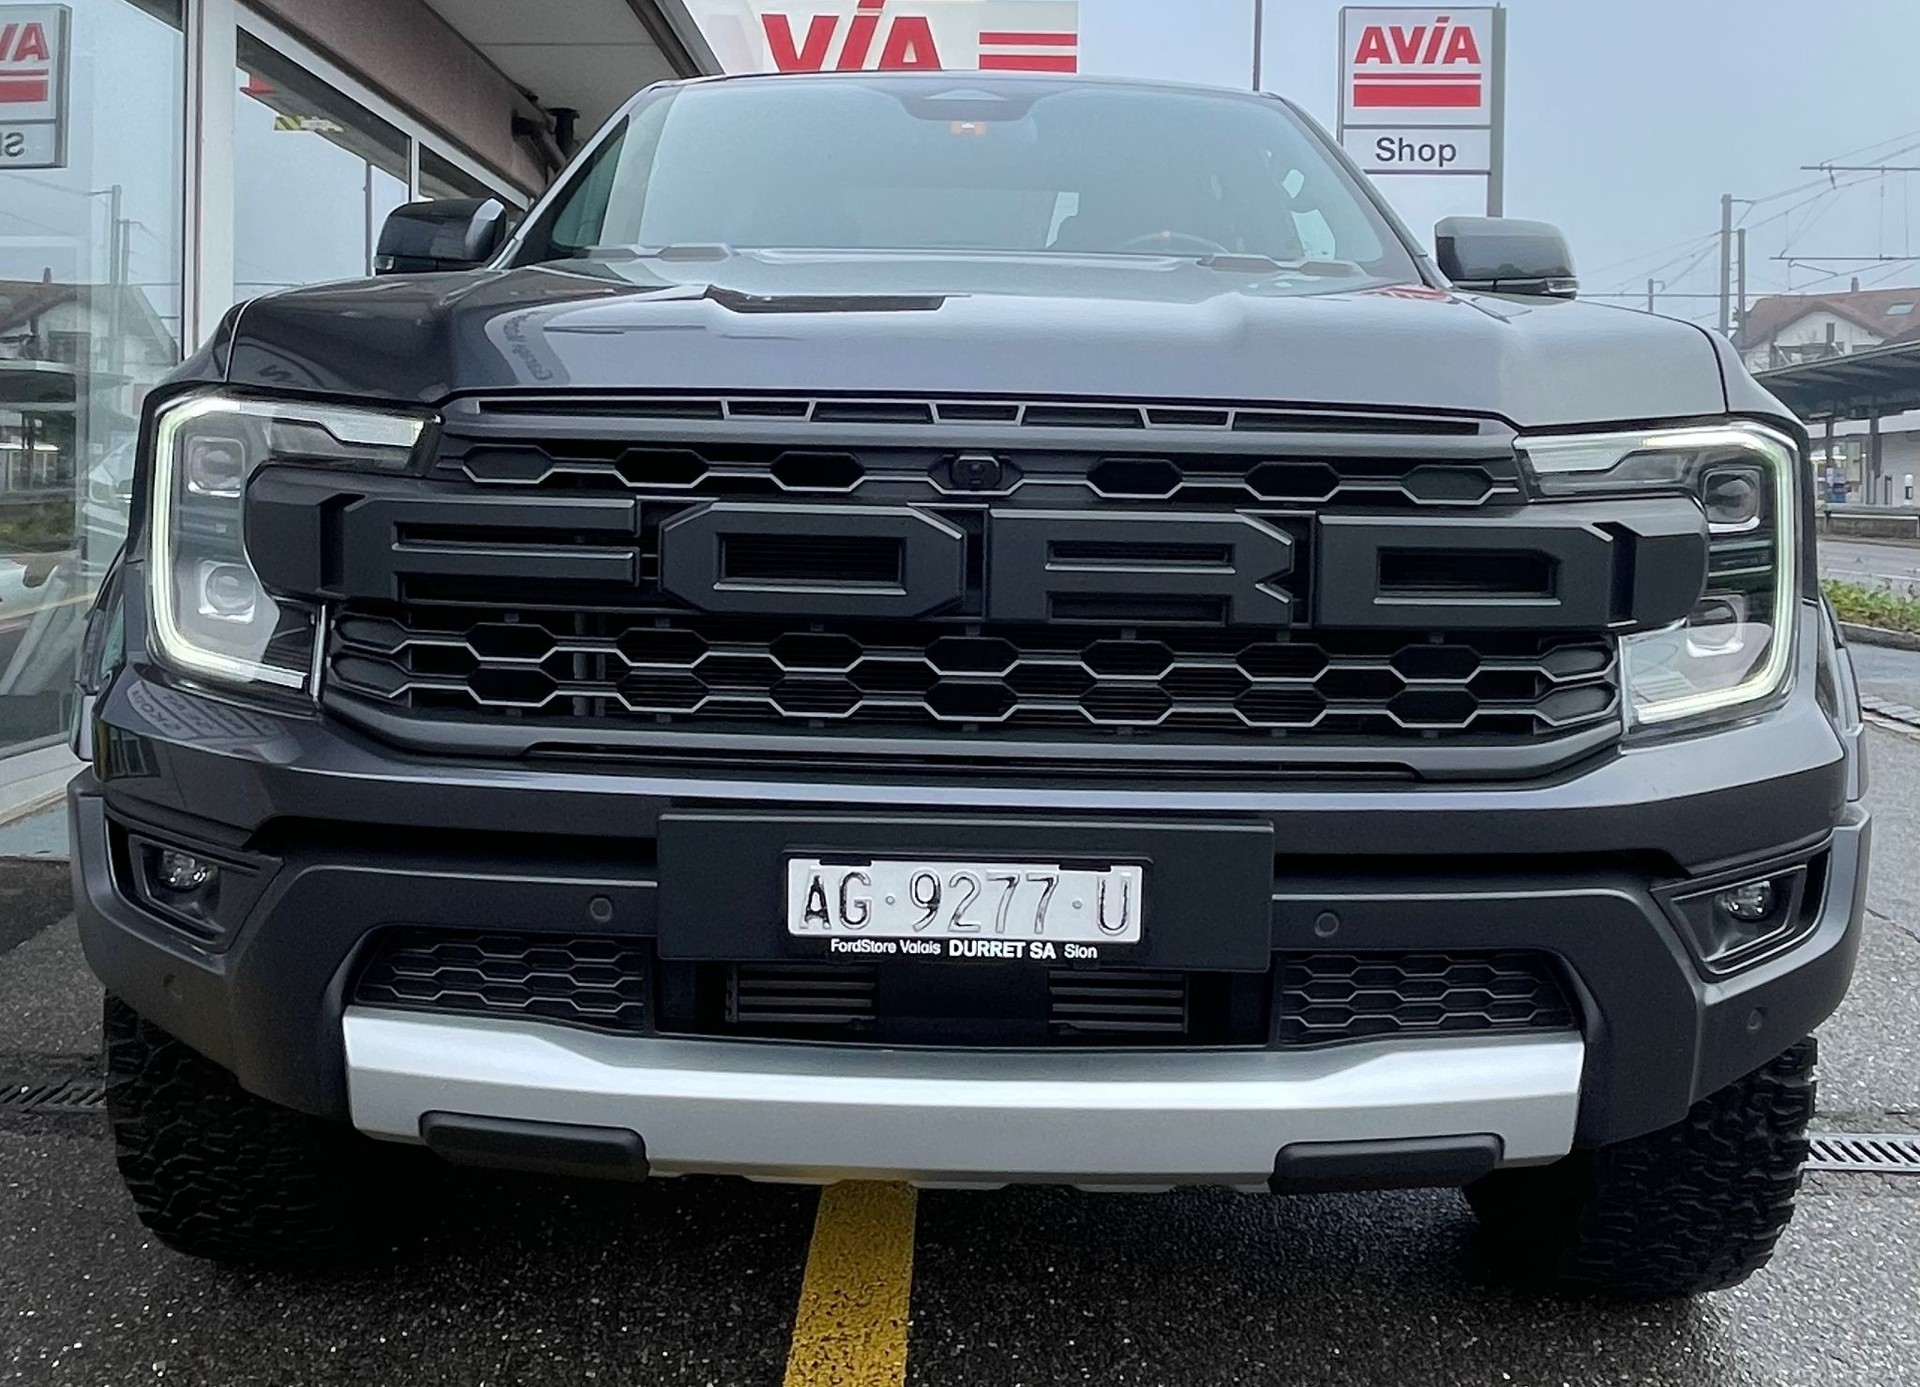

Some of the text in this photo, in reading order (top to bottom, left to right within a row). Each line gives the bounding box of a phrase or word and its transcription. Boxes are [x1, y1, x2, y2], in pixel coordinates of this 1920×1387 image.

[761, 0, 942, 72] VIA
[1354, 16, 1481, 65] AVIA
[1375, 136, 1457, 168] Shop
[343, 497, 1613, 628] FORD
[799, 867, 1132, 936] AG 9277 U
[830, 938, 1098, 960] FordStore Valais DURRET SA Sion
